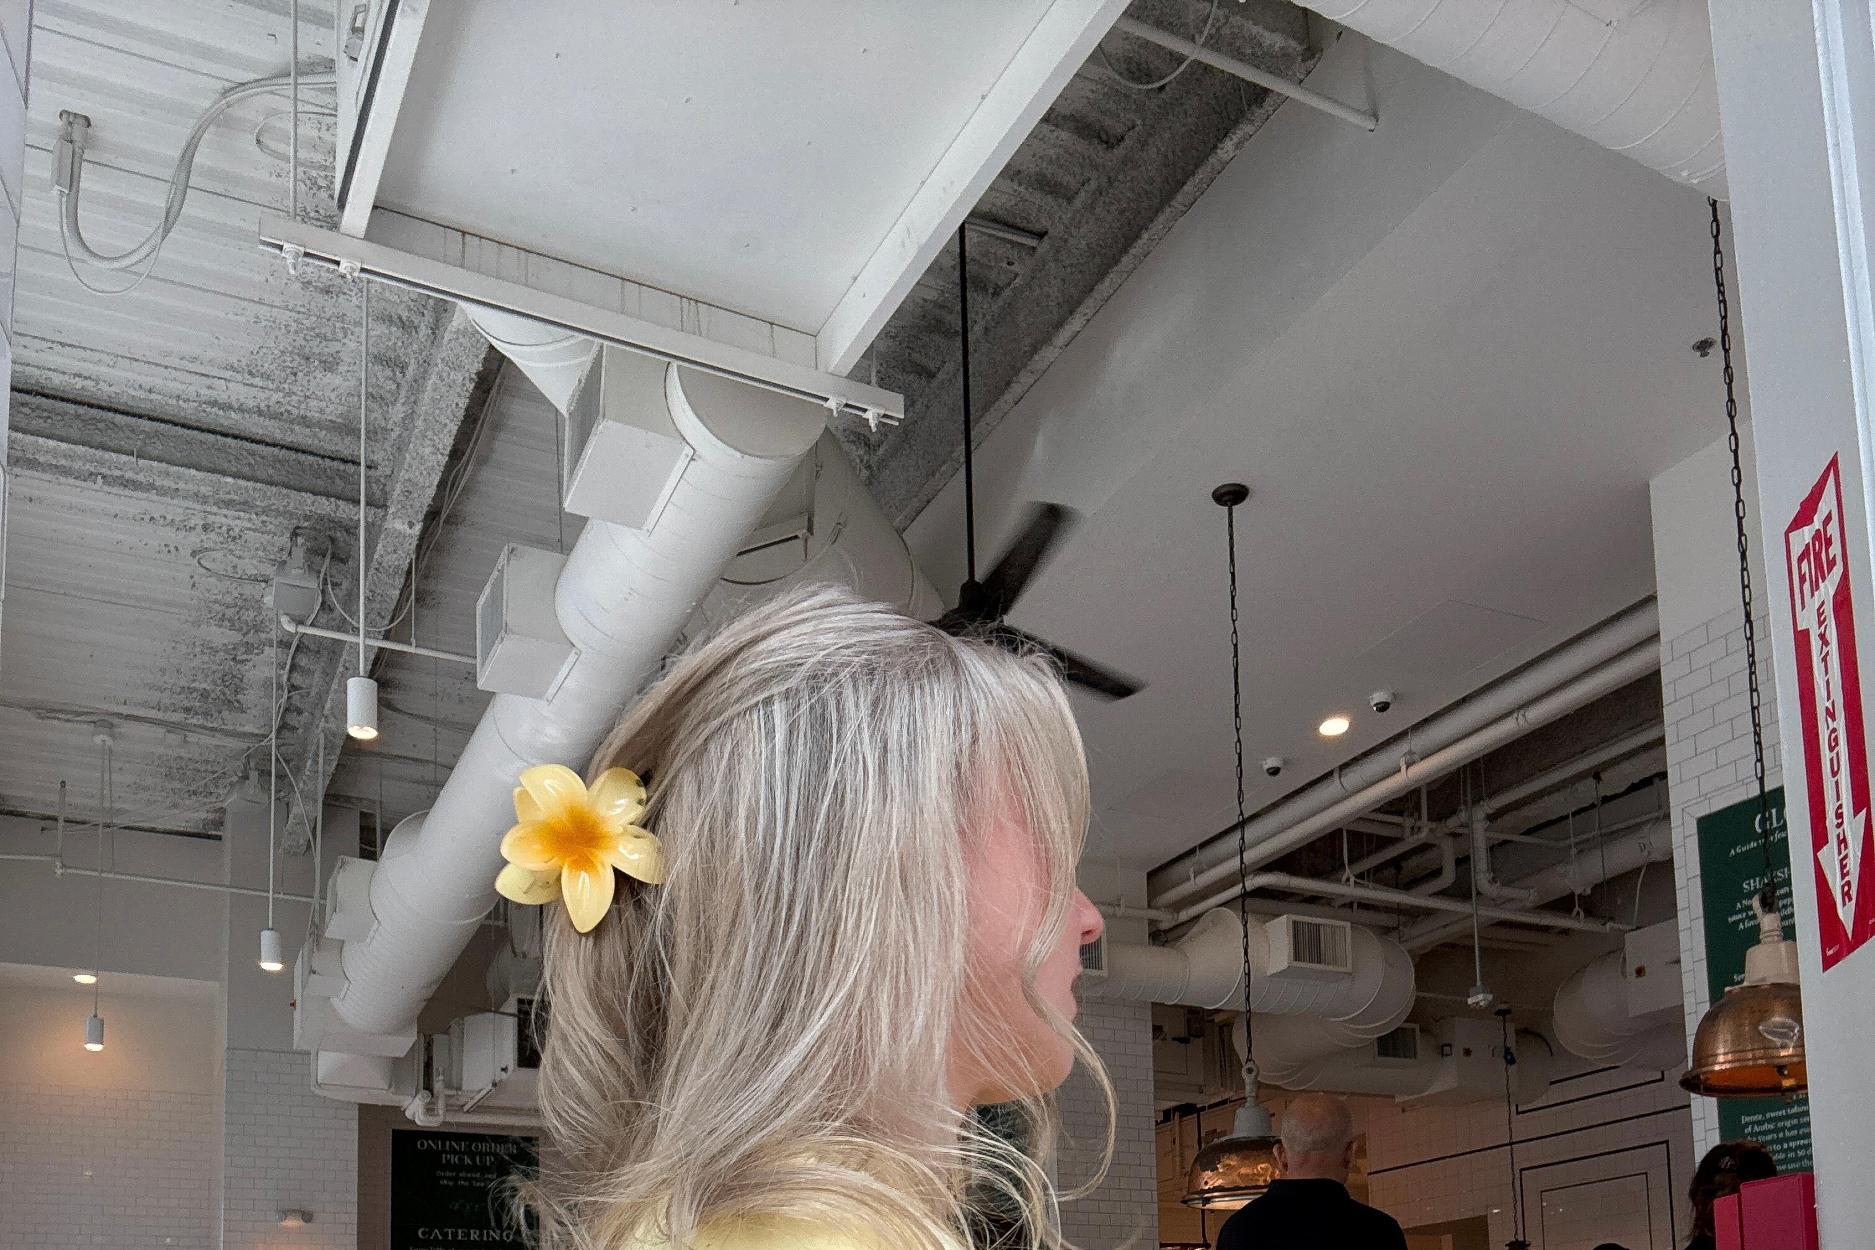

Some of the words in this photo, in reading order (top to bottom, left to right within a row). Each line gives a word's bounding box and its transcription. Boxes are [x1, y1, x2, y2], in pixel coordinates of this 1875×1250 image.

[1797, 509, 1837, 612] FIRE
[1816, 599, 1853, 908] EXTINGUISHER
[416, 1138, 467, 1152] ONLINE
[471, 1141, 518, 1153] ORDER
[441, 1153, 473, 1166] PICK
[475, 1155, 495, 1167] UP
[417, 1227, 514, 1242] CATERING
